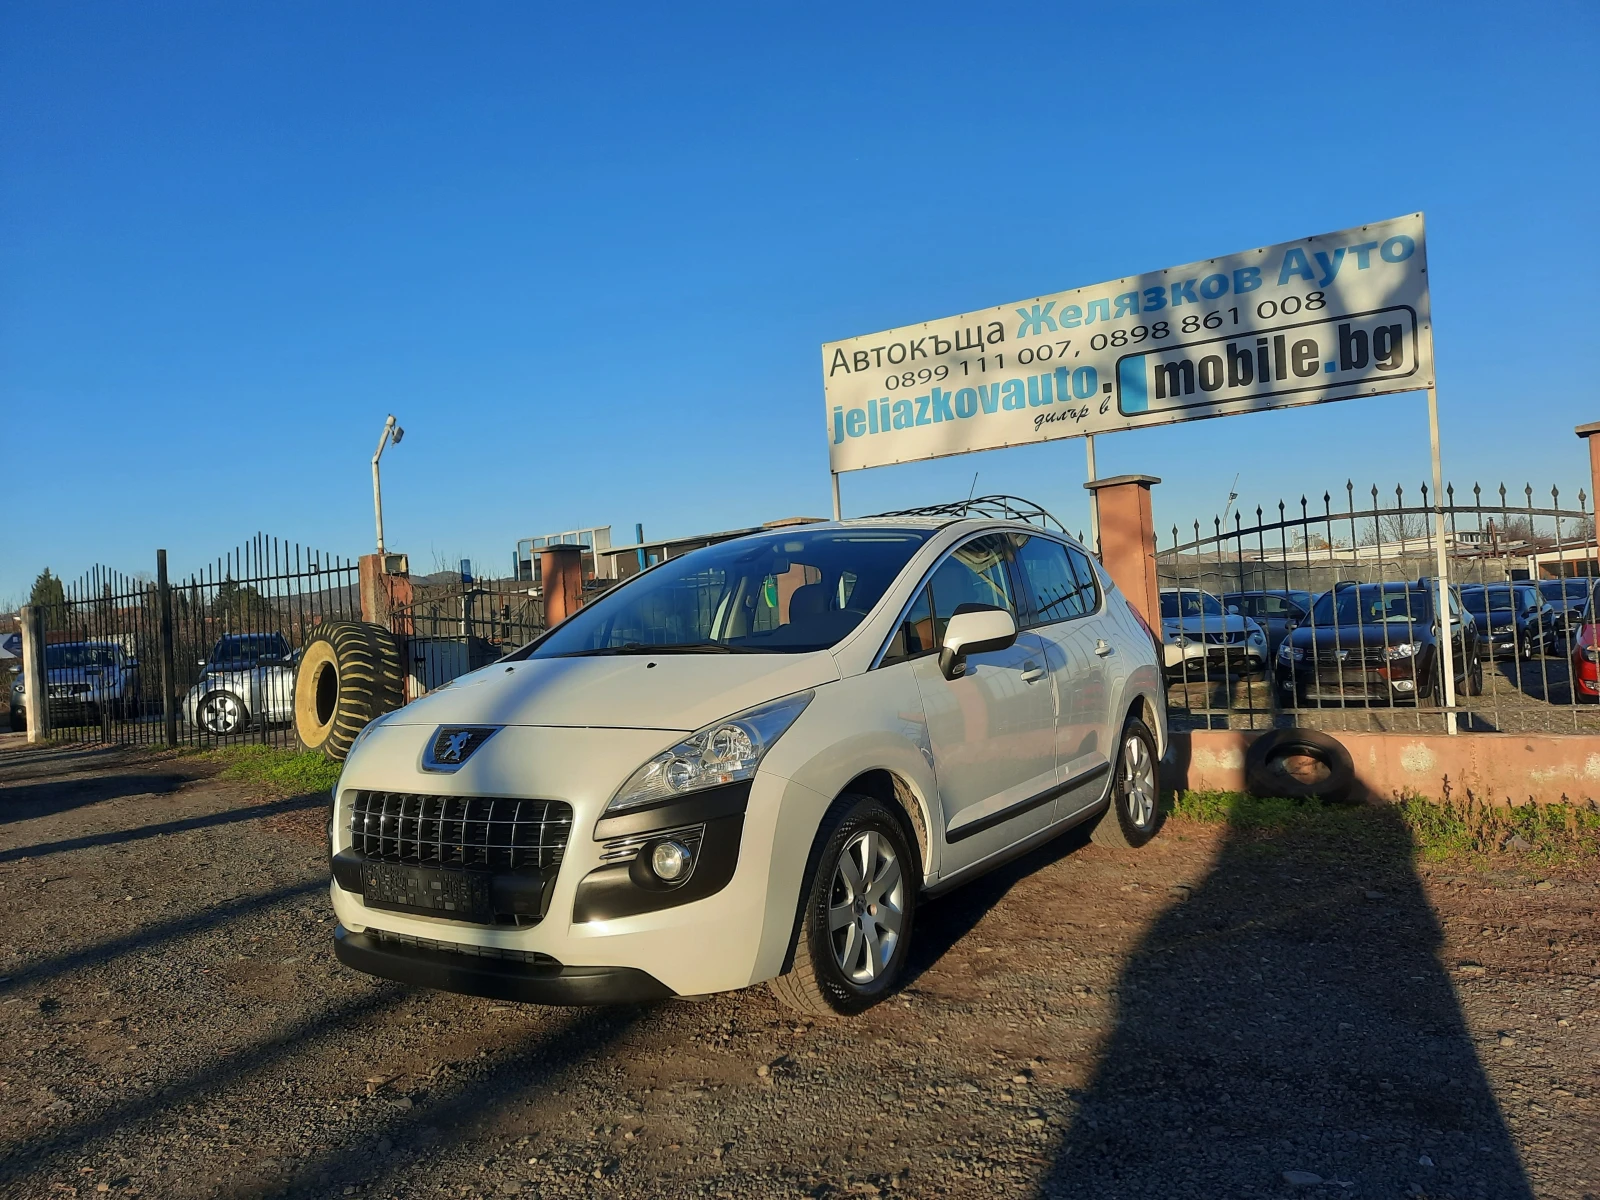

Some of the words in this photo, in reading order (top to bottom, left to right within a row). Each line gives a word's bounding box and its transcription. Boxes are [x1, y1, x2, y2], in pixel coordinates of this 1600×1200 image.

[829, 321, 1005, 377] Автокъща
[1015, 266, 1262, 339] Желязков
[1277, 234, 1415, 288] Ауто
[885, 365, 949, 390] 0899
[960, 353, 1004, 376] 111
[1018, 340, 1080, 365] 007,
[1090, 321, 1170, 351] 0898
[1181, 307, 1239, 334] 861
[1257, 291, 1327, 319] 008
[1154, 323, 1404, 400] mobile.bg
